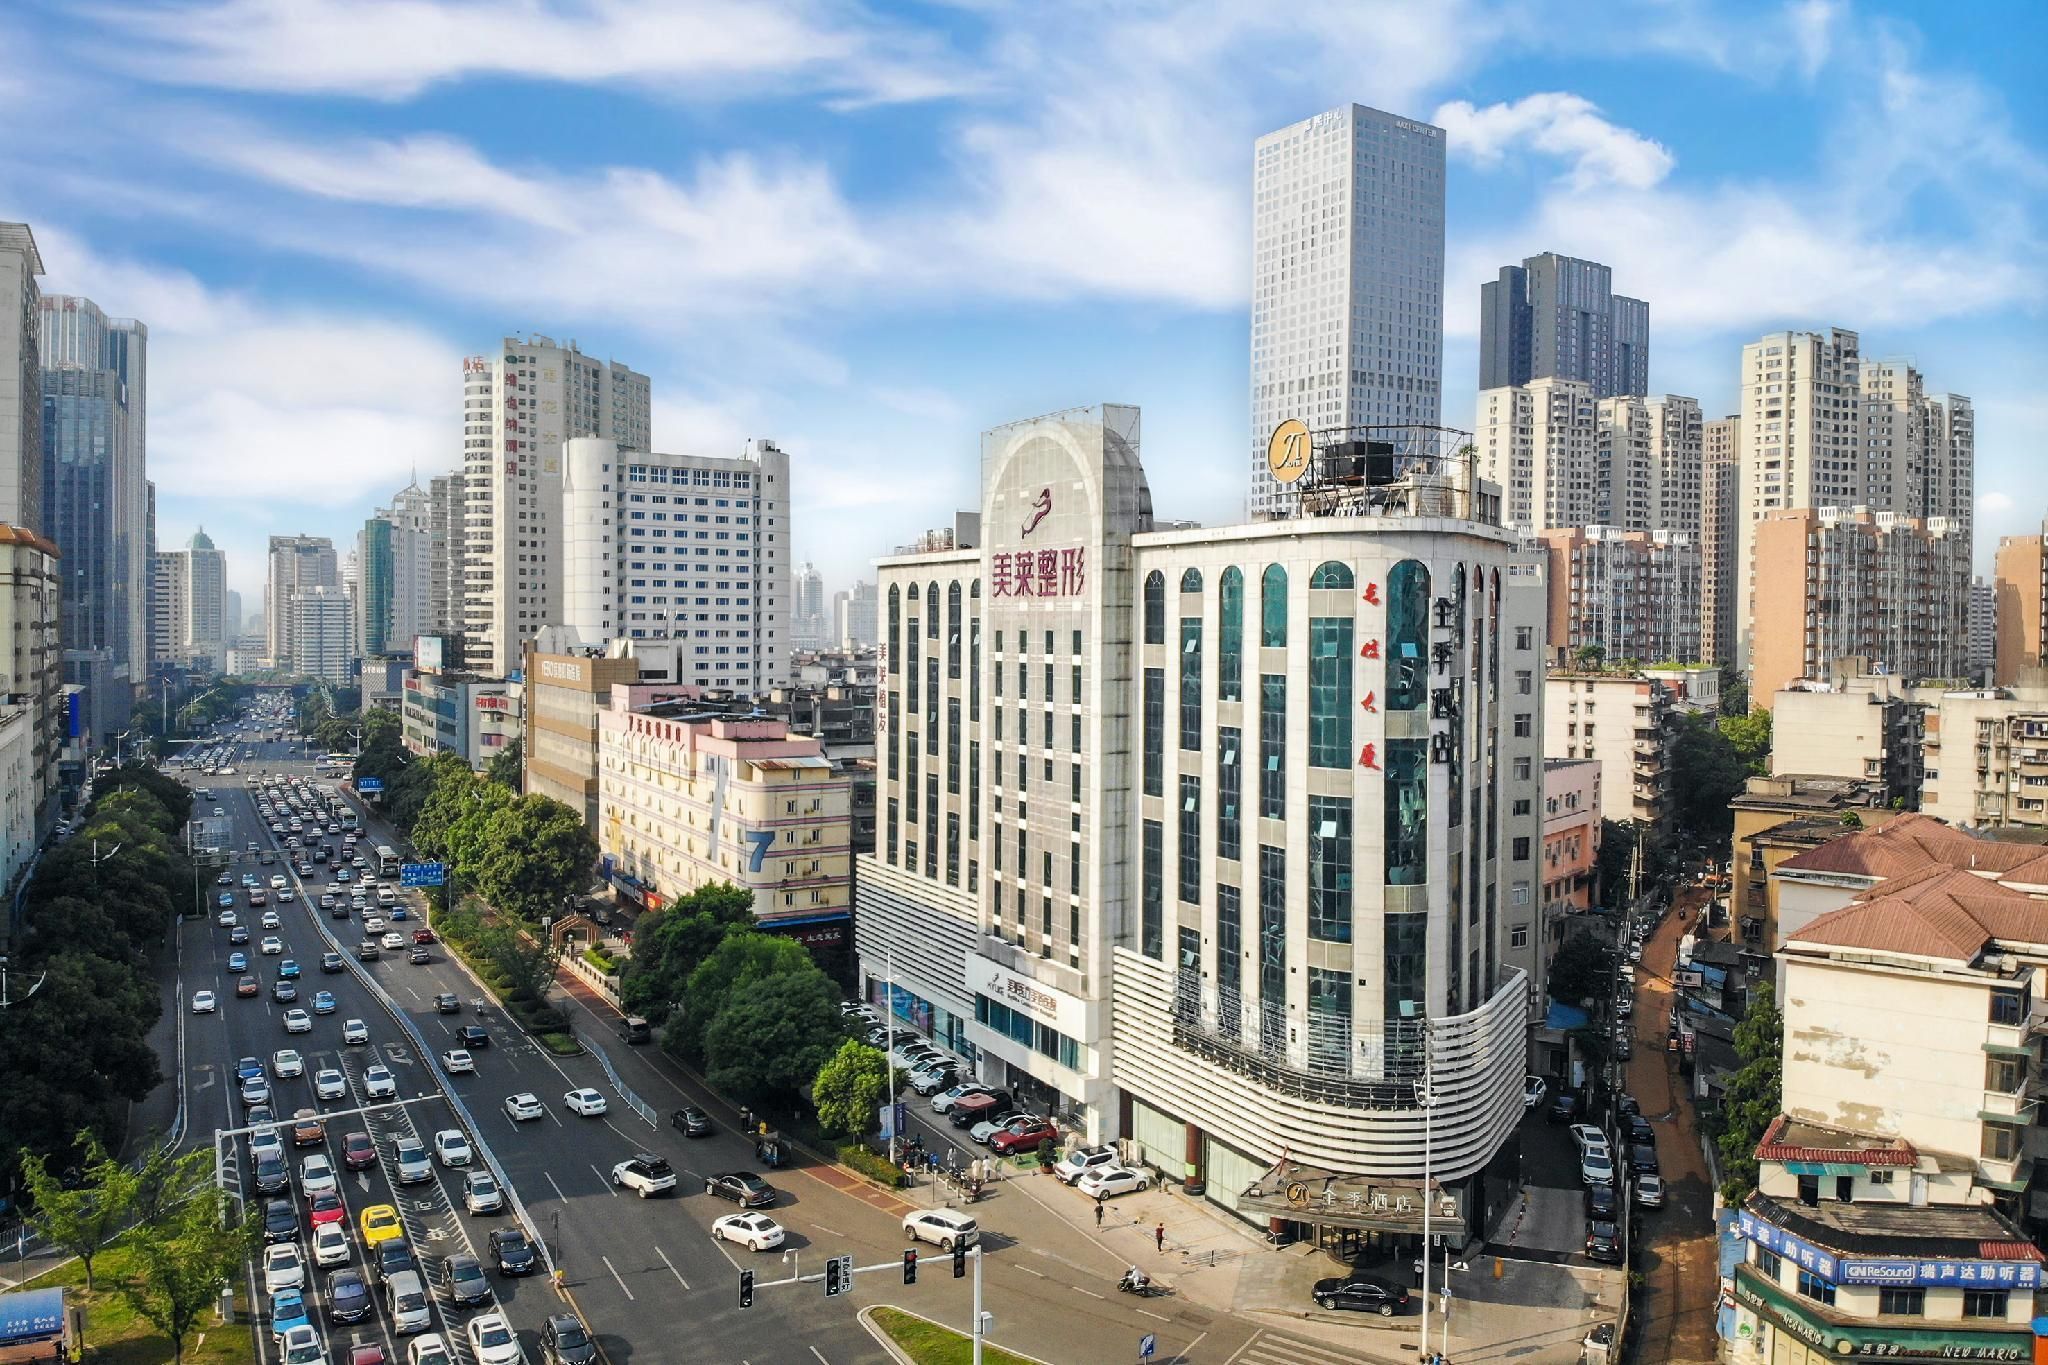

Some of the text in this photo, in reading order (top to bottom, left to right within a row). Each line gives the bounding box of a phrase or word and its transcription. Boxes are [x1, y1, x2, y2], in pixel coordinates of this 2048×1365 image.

[992, 546, 1085, 598] 美莱整形
[1321, 1189, 1412, 1213] 全季酒店
[1920, 1264, 2034, 1281] 瑞声达助听器
[1977, 1347, 2018, 1361] MARIO
